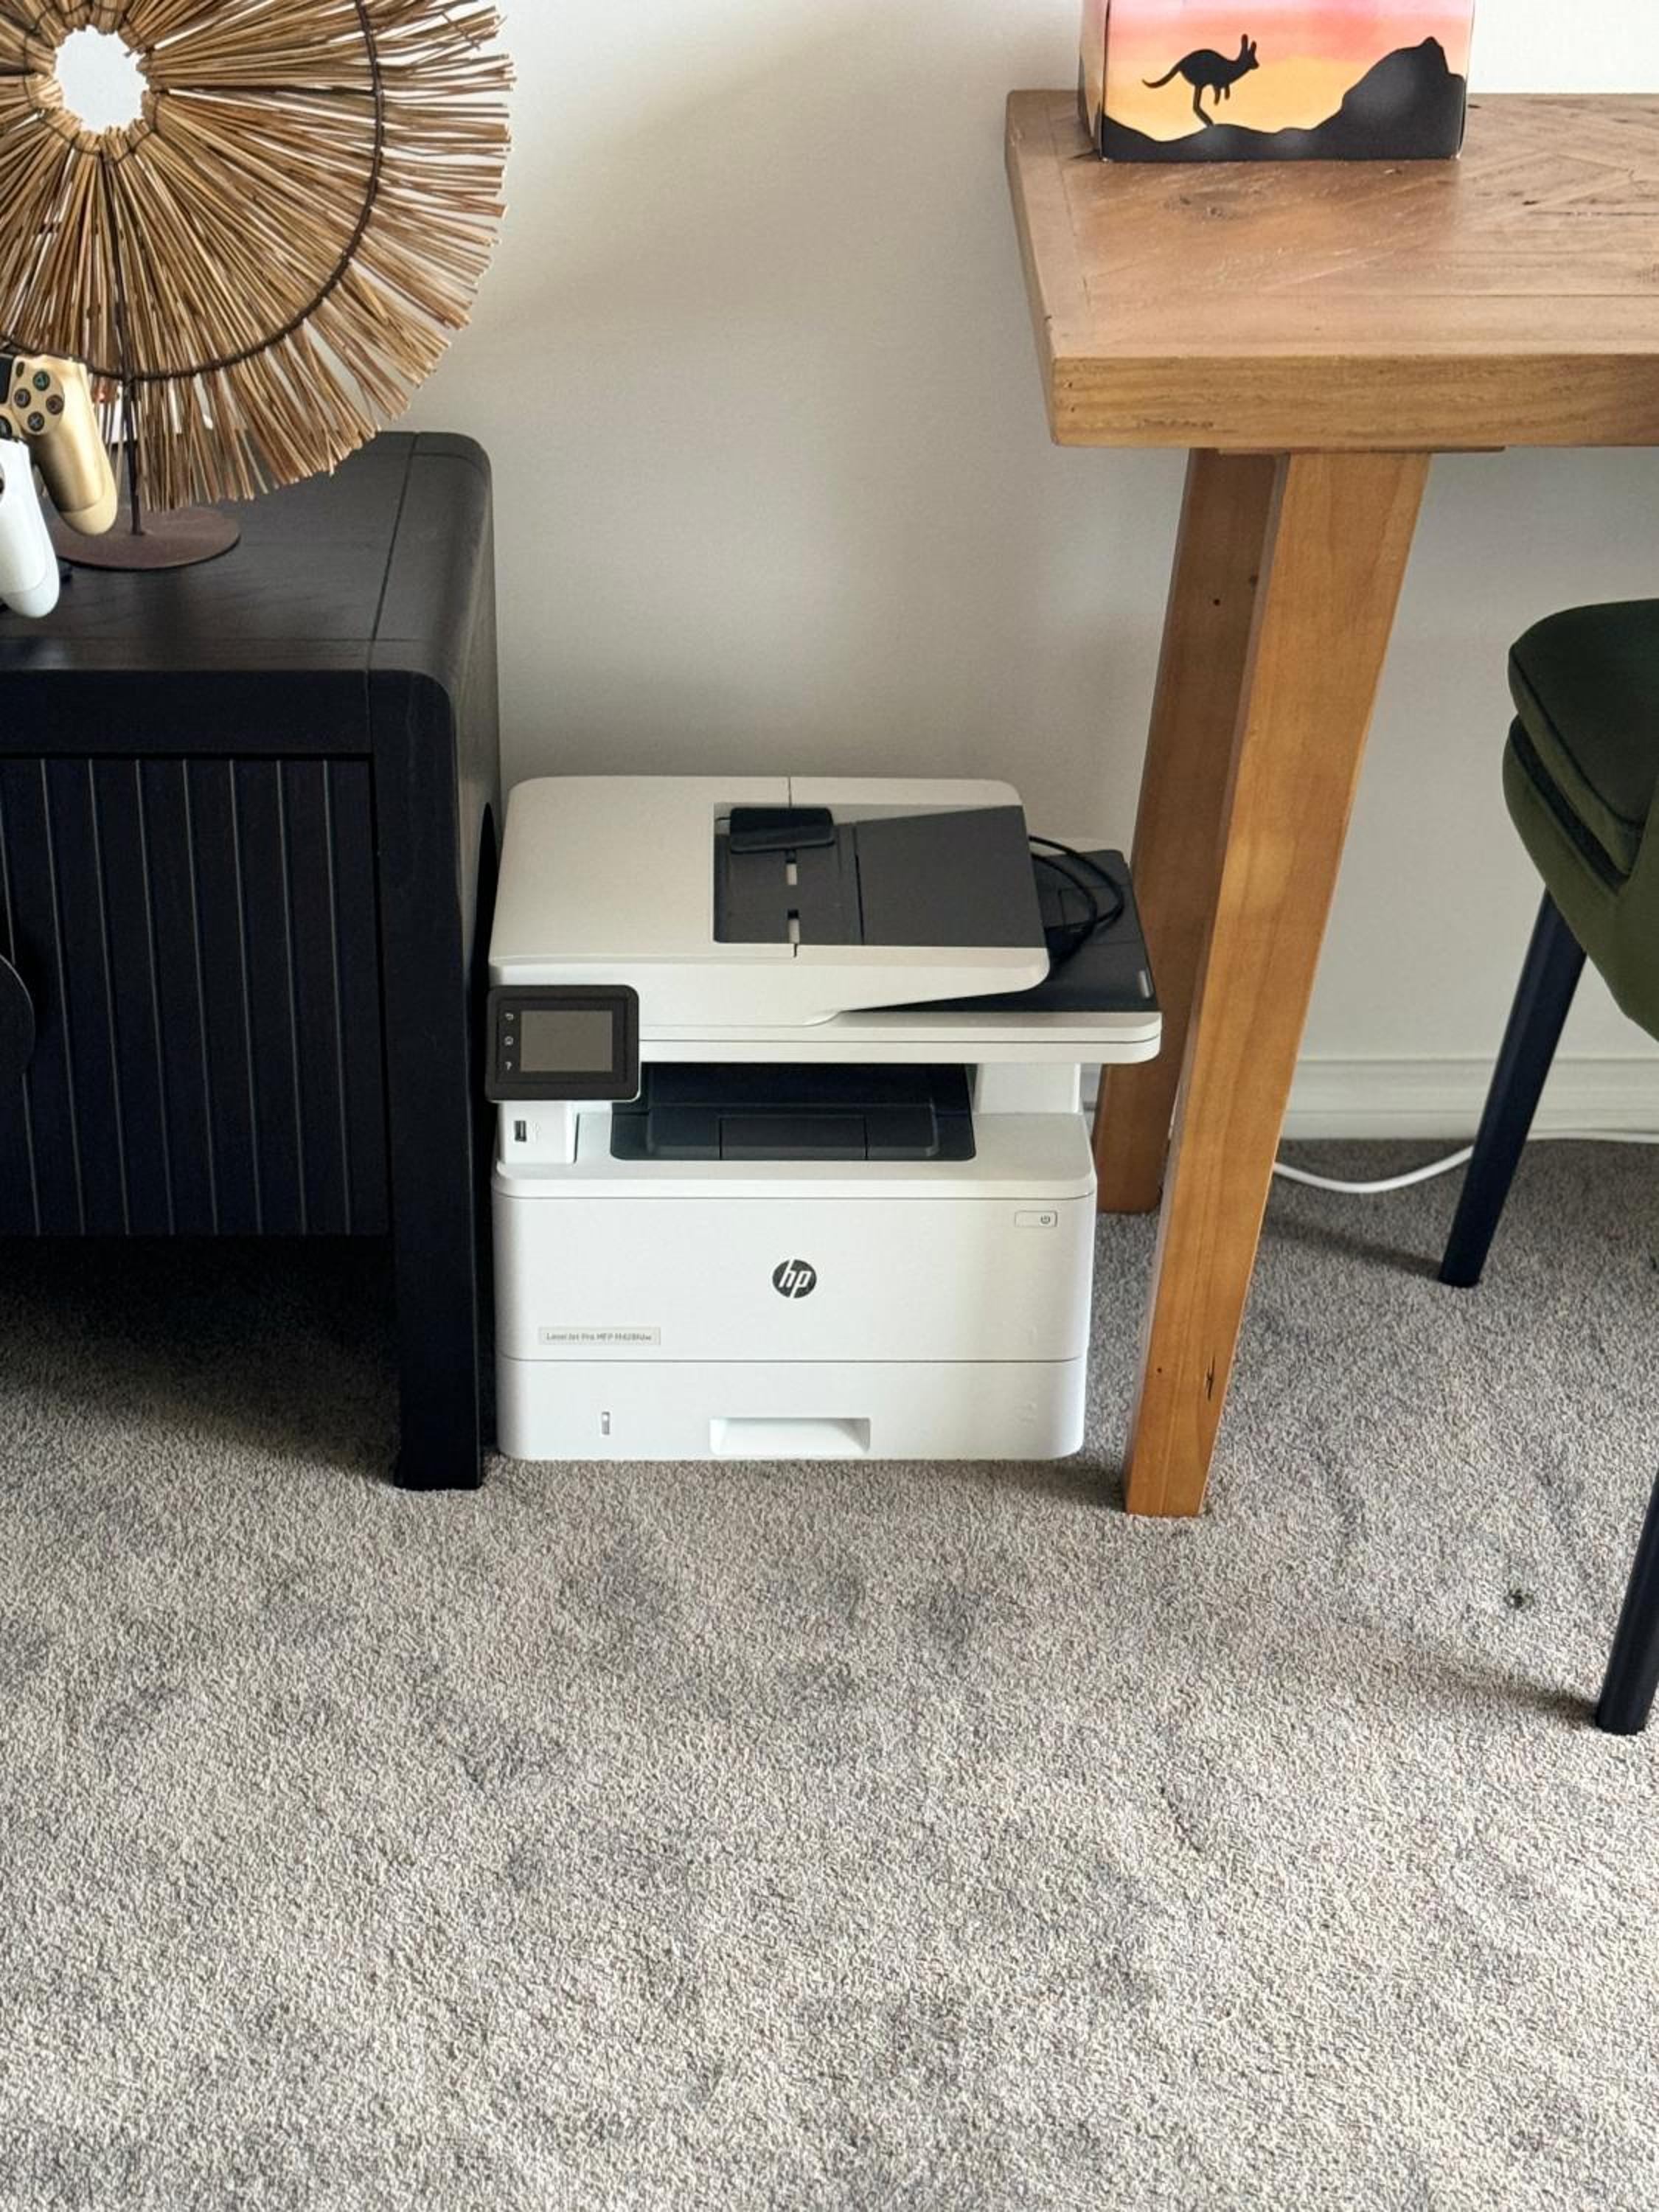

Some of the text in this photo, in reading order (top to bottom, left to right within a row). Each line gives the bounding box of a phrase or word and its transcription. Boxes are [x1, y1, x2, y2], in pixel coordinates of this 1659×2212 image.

[776, 1258, 813, 1298] hp
[581, 1332, 595, 1340] Pro
[597, 1332, 613, 1340] MFP
